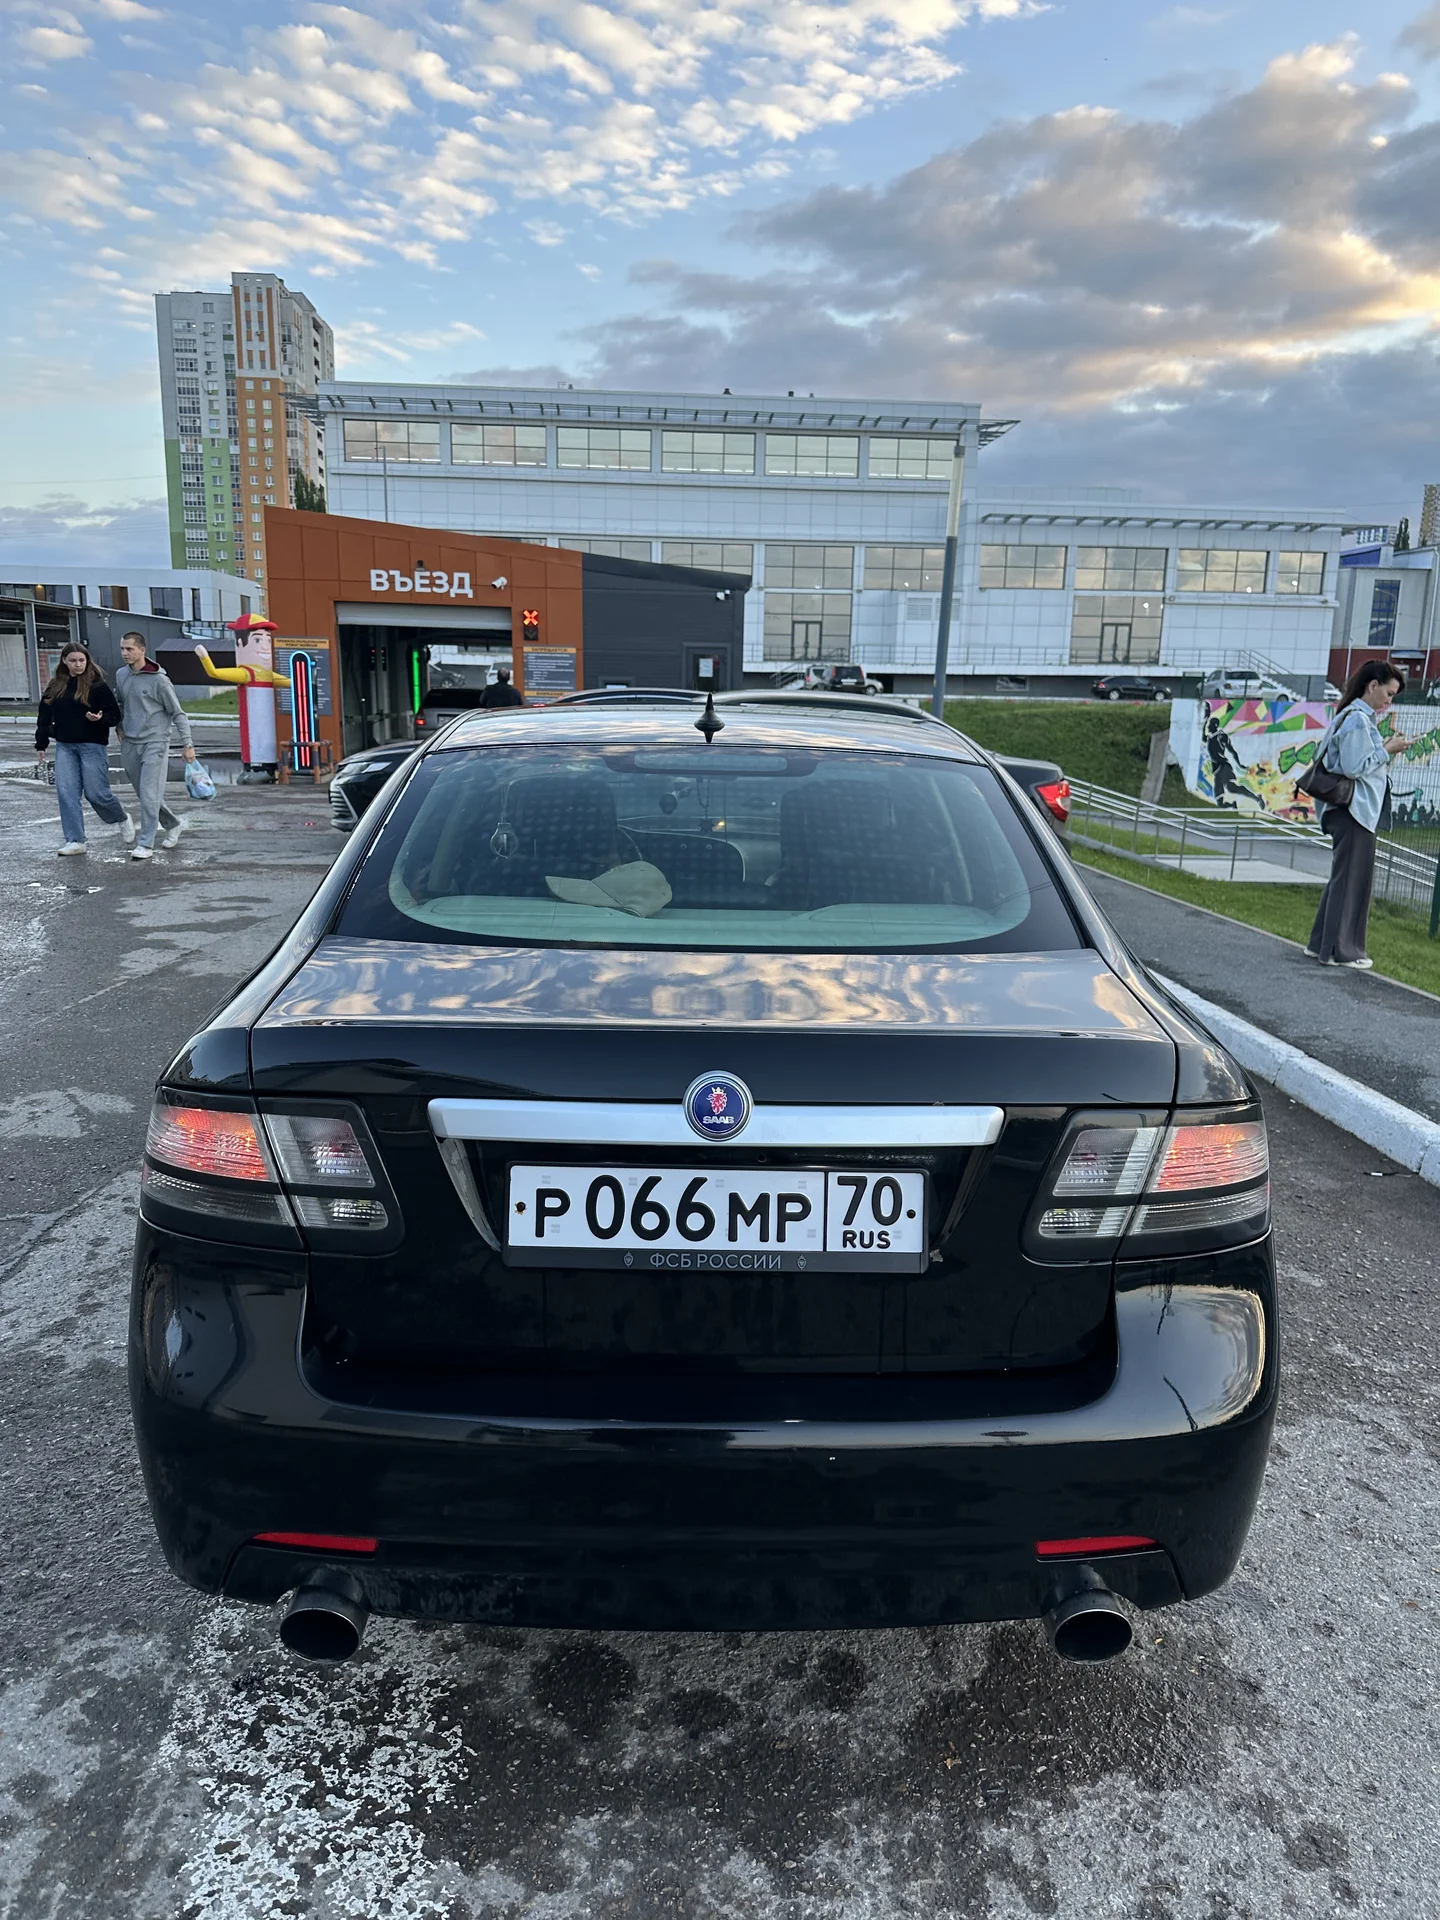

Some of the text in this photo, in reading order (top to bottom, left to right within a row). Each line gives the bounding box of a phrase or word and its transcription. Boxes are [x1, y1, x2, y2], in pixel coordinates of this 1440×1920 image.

[370, 568, 474, 598] ВЪЕЗД
[702, 1115, 735, 1125] SAAB
[837, 1176, 903, 1226] 70
[842, 1230, 891, 1249] RUS
[650, 1253, 782, 1270] ФСБ РОССИИ
